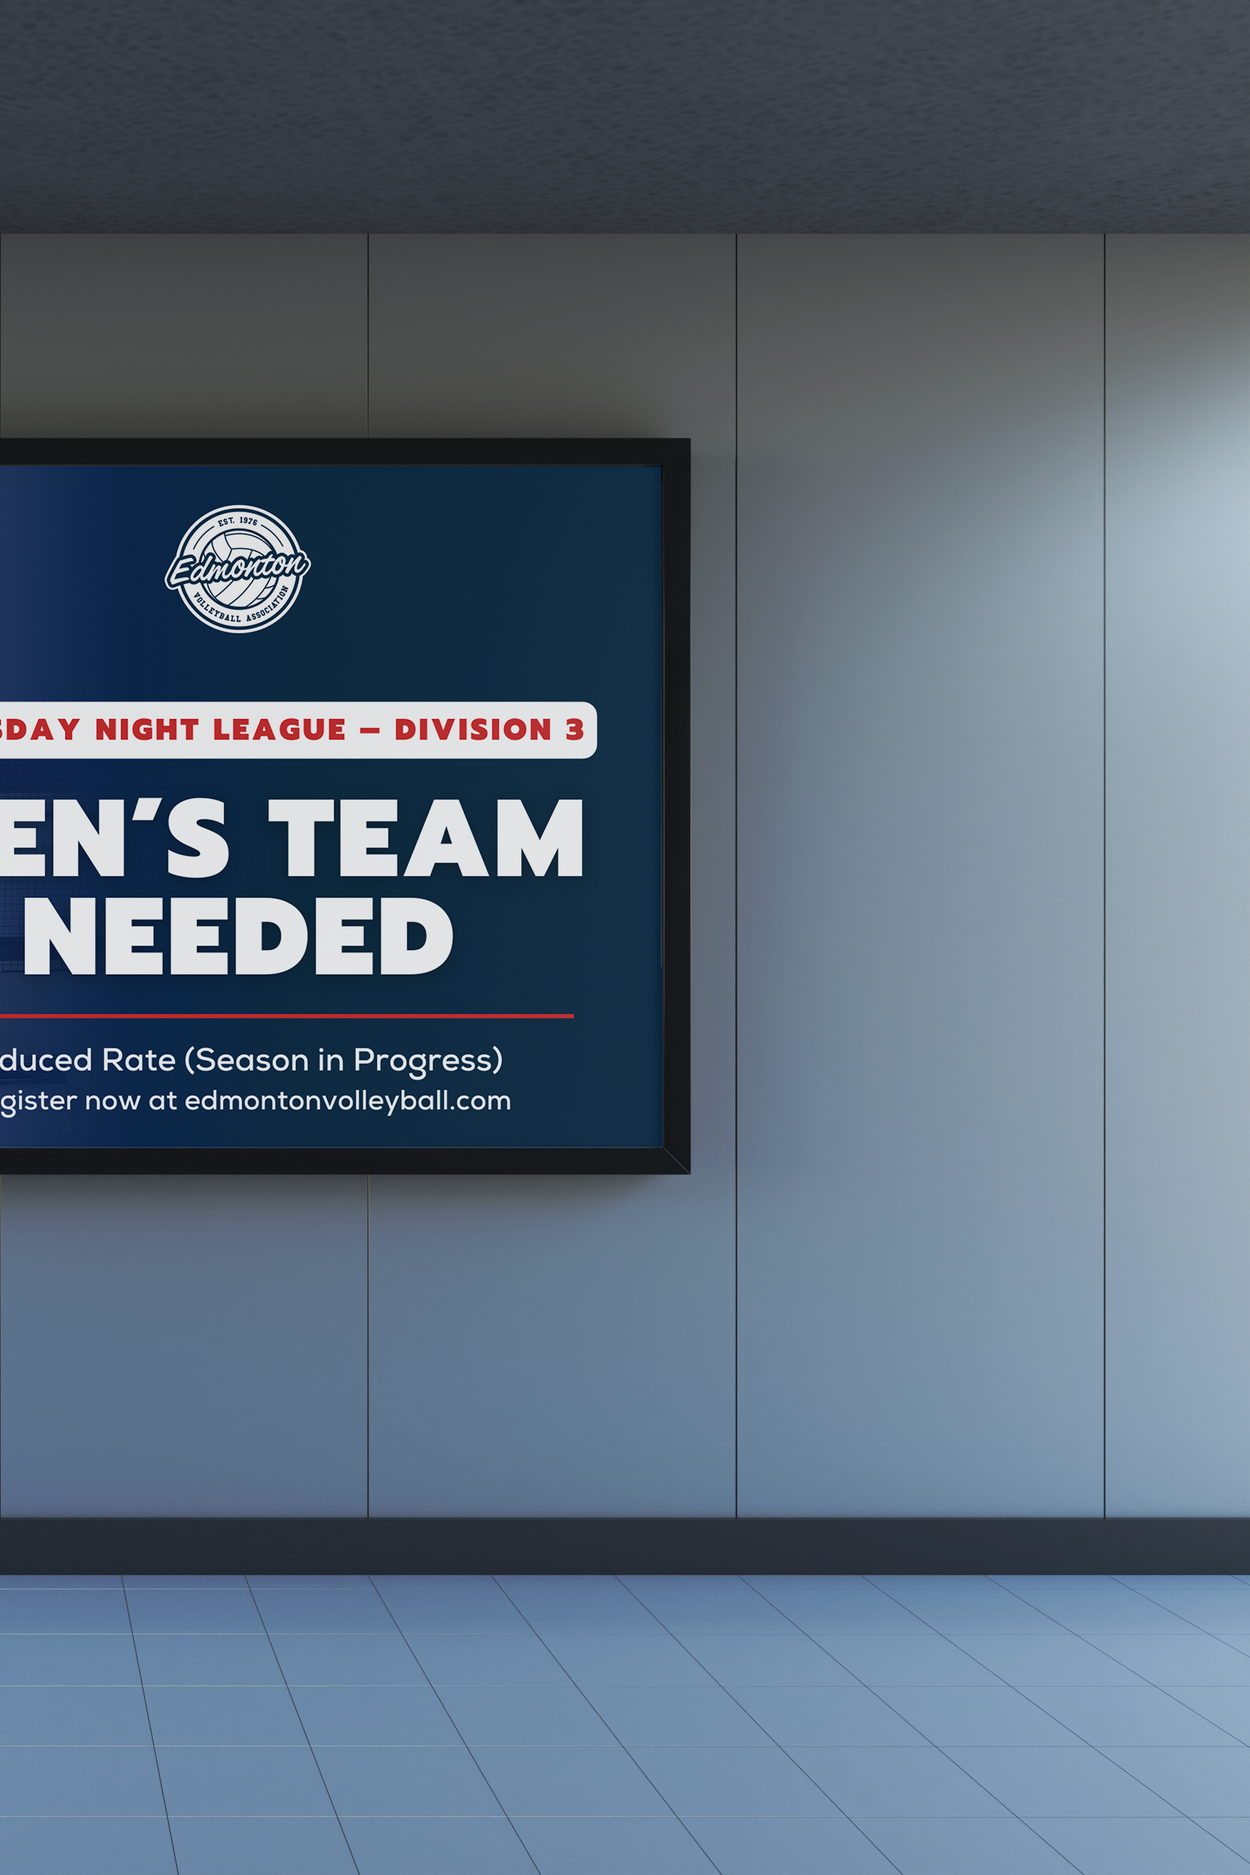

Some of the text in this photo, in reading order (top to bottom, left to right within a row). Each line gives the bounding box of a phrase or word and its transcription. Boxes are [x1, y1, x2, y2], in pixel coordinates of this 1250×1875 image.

[217, 516, 258, 527] EST. 1976
[169, 552, 307, 585] Edmonton
[193, 585, 289, 622] VOLLEYBALL ASSOCIATION
[95, 717, 200, 741] NIGHT
[213, 717, 346, 741] LEAGUE
[395, 717, 551, 741] DIVISION
[565, 717, 584, 741] 3
[268, 799, 583, 877] TEAM
[24, 897, 454, 975] NEEDED
[103, 1047, 176, 1072] Rate
[185, 1045, 309, 1075] (Season
[318, 1047, 344, 1071] in
[355, 1045, 503, 1081] Progress)
[85, 1095, 142, 1111] now
[149, 1091, 178, 1111] at
[185, 1089, 511, 1117] edmontonvolleyball.com
